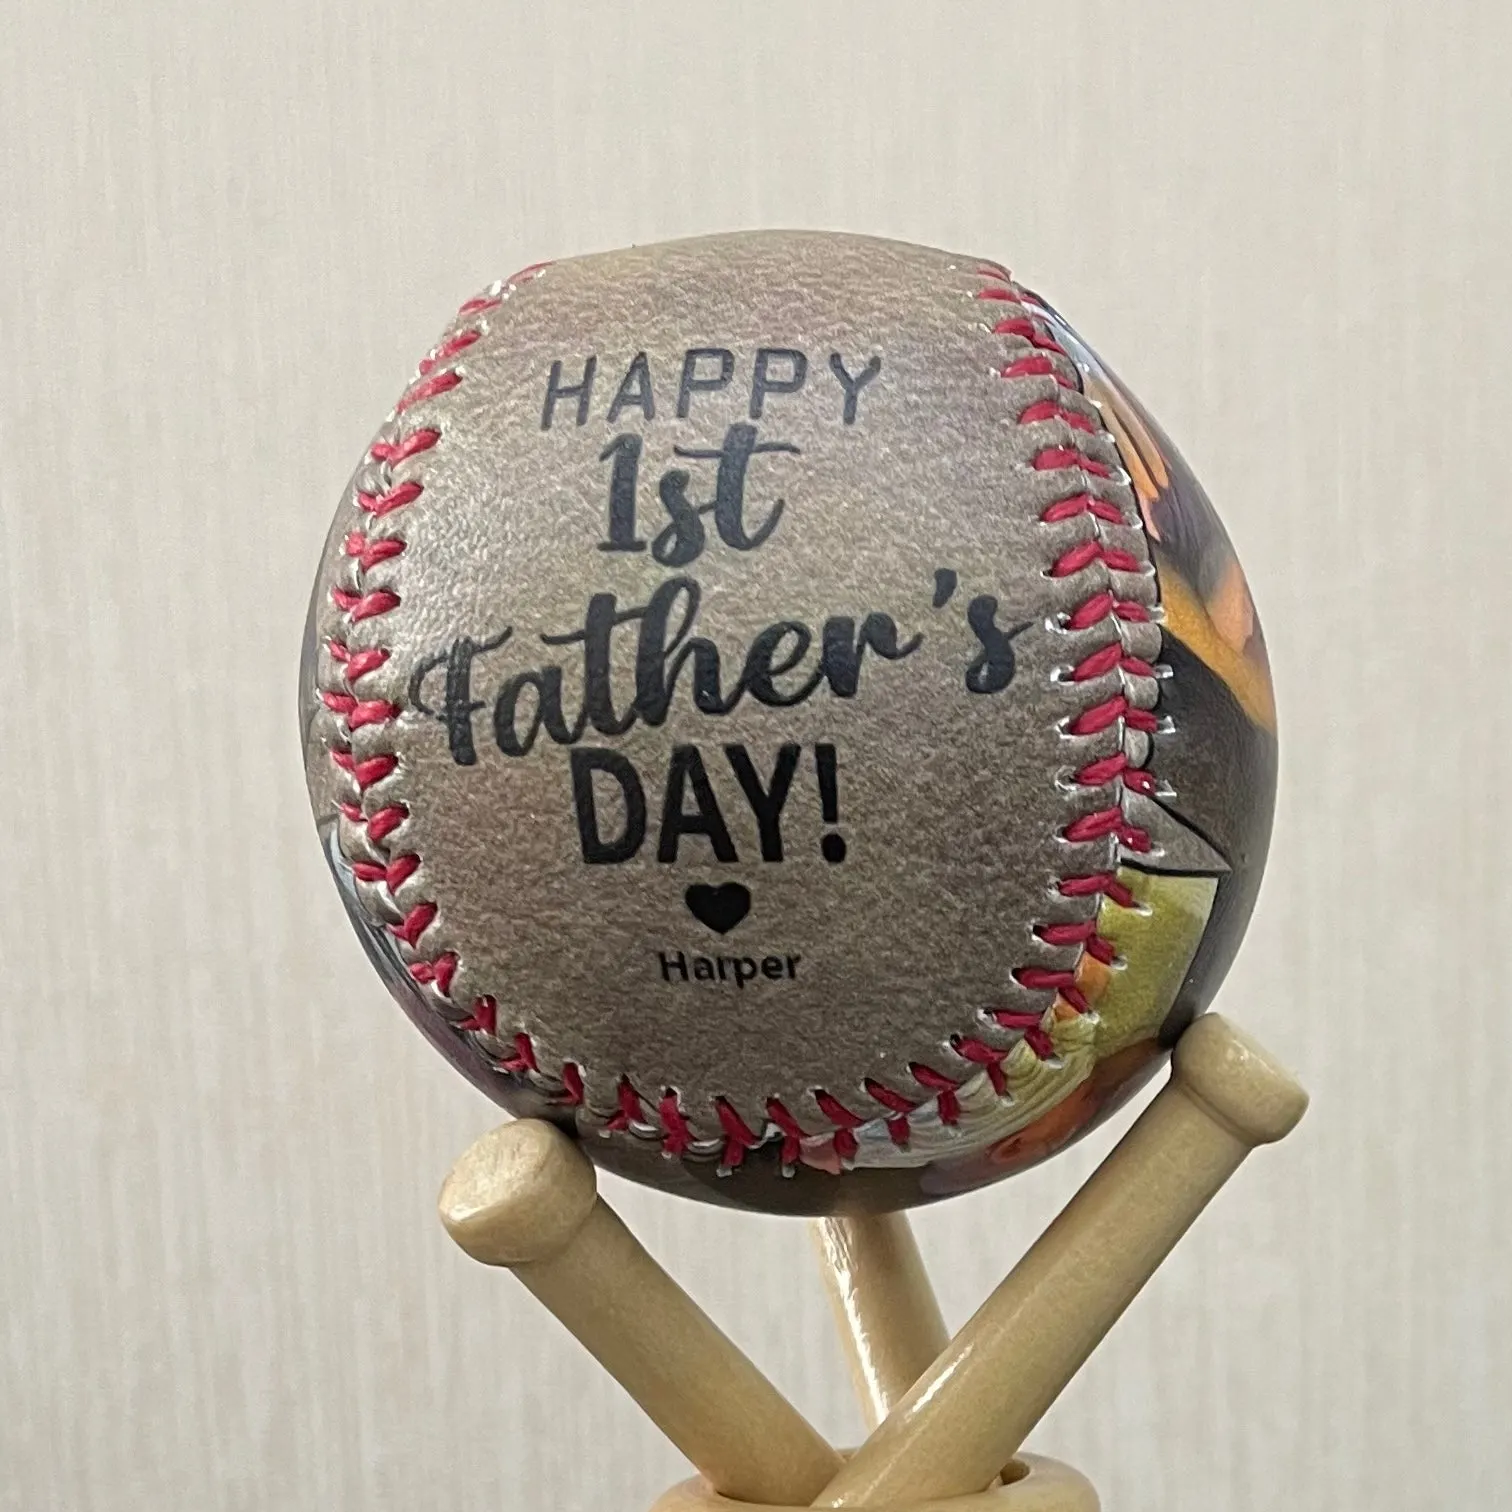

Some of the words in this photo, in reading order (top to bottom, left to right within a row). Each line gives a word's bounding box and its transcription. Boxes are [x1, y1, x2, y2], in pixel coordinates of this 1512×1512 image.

[542, 347, 881, 430] HAPPY
[599, 423, 800, 567] 1st
[408, 569, 1033, 767] Father's
[570, 743, 847, 865] DAY!
[659, 950, 801, 984] Harper
